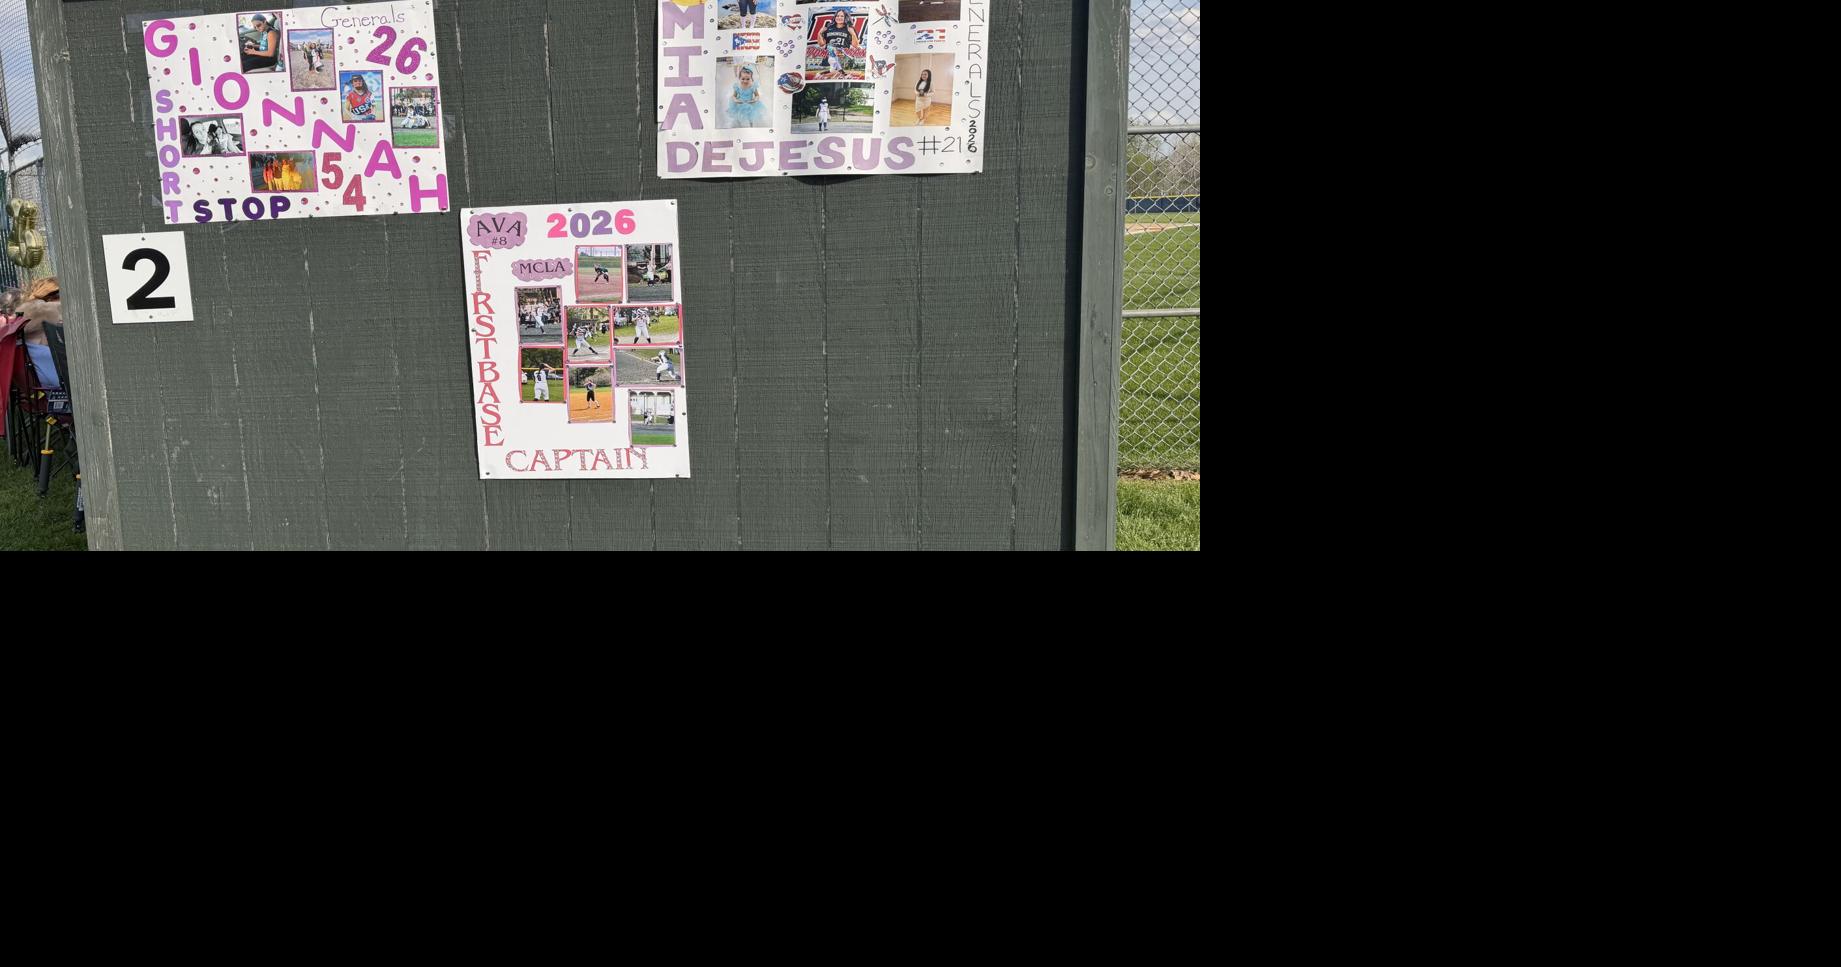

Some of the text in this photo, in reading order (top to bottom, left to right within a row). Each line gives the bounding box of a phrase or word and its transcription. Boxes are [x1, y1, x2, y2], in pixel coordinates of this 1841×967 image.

[321, 4, 405, 28] Generals
[366, 25, 427, 75] 26
[661, 0, 704, 130] MIA
[966, 0, 984, 119] NERALS
[155, 89, 184, 223] SHORT
[666, 136, 916, 173] DEJESUS
[917, 135, 963, 155] #21
[321, 152, 367, 212] 54
[193, 195, 291, 224] STOP
[546, 209, 637, 239] 2026
[476, 217, 521, 237] AVA
[492, 236, 508, 246] #8
[122, 247, 176, 311] 2
[519, 261, 566, 274] MCLA
[505, 447, 649, 473] CAPTAIN
